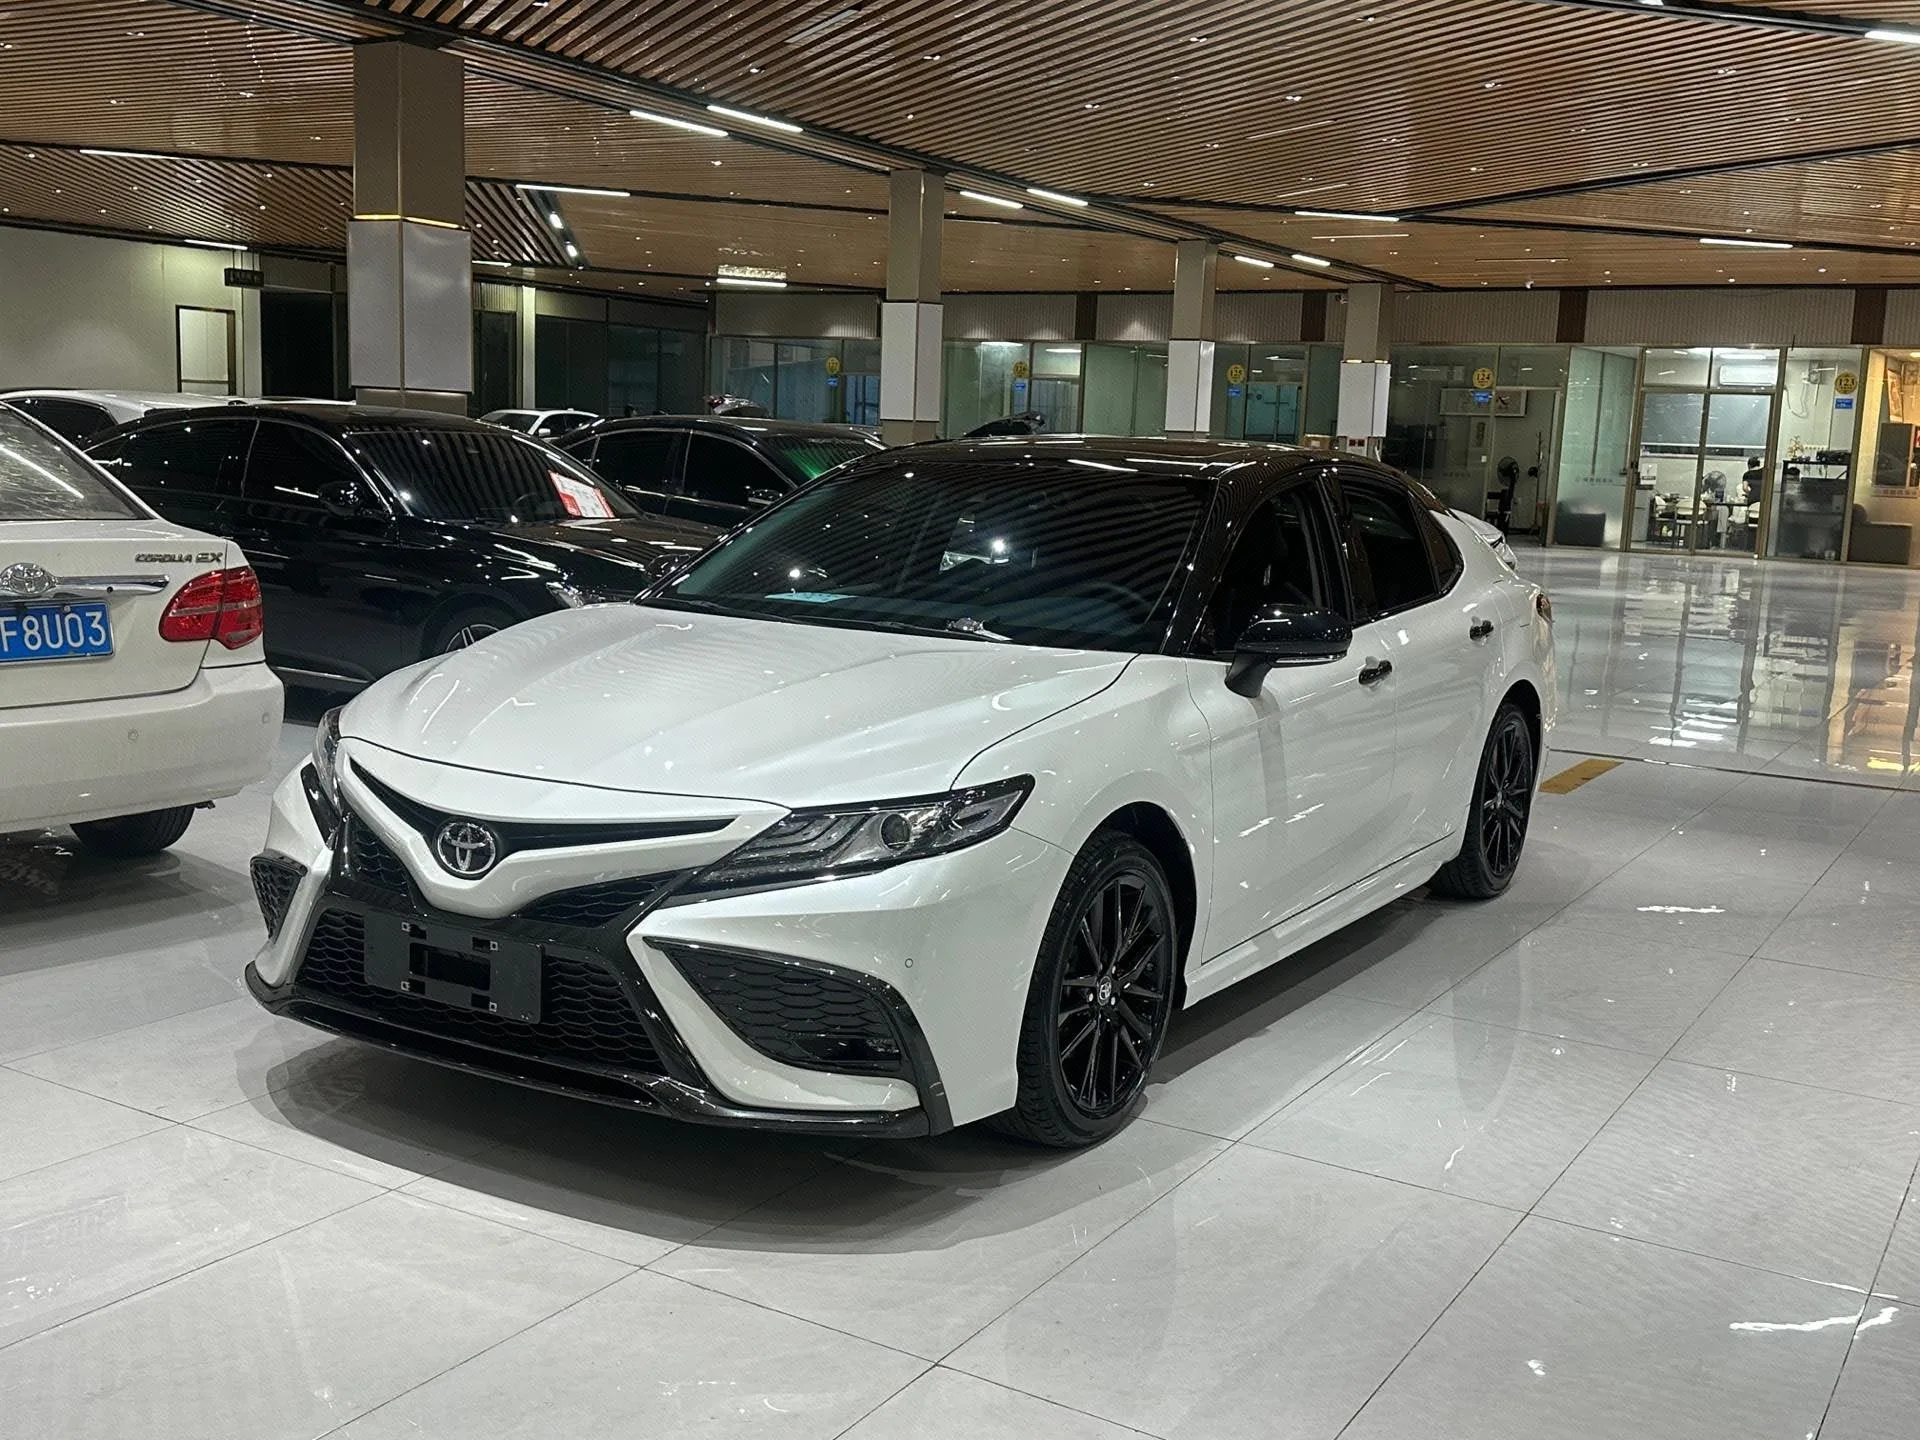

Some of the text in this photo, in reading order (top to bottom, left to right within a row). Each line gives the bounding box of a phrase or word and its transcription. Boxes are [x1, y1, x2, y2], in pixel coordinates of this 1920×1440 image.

[1476, 373, 1491, 381] 124
[135, 552, 223, 563] COROLLA EX
[0, 611, 106, 652] F8U03
